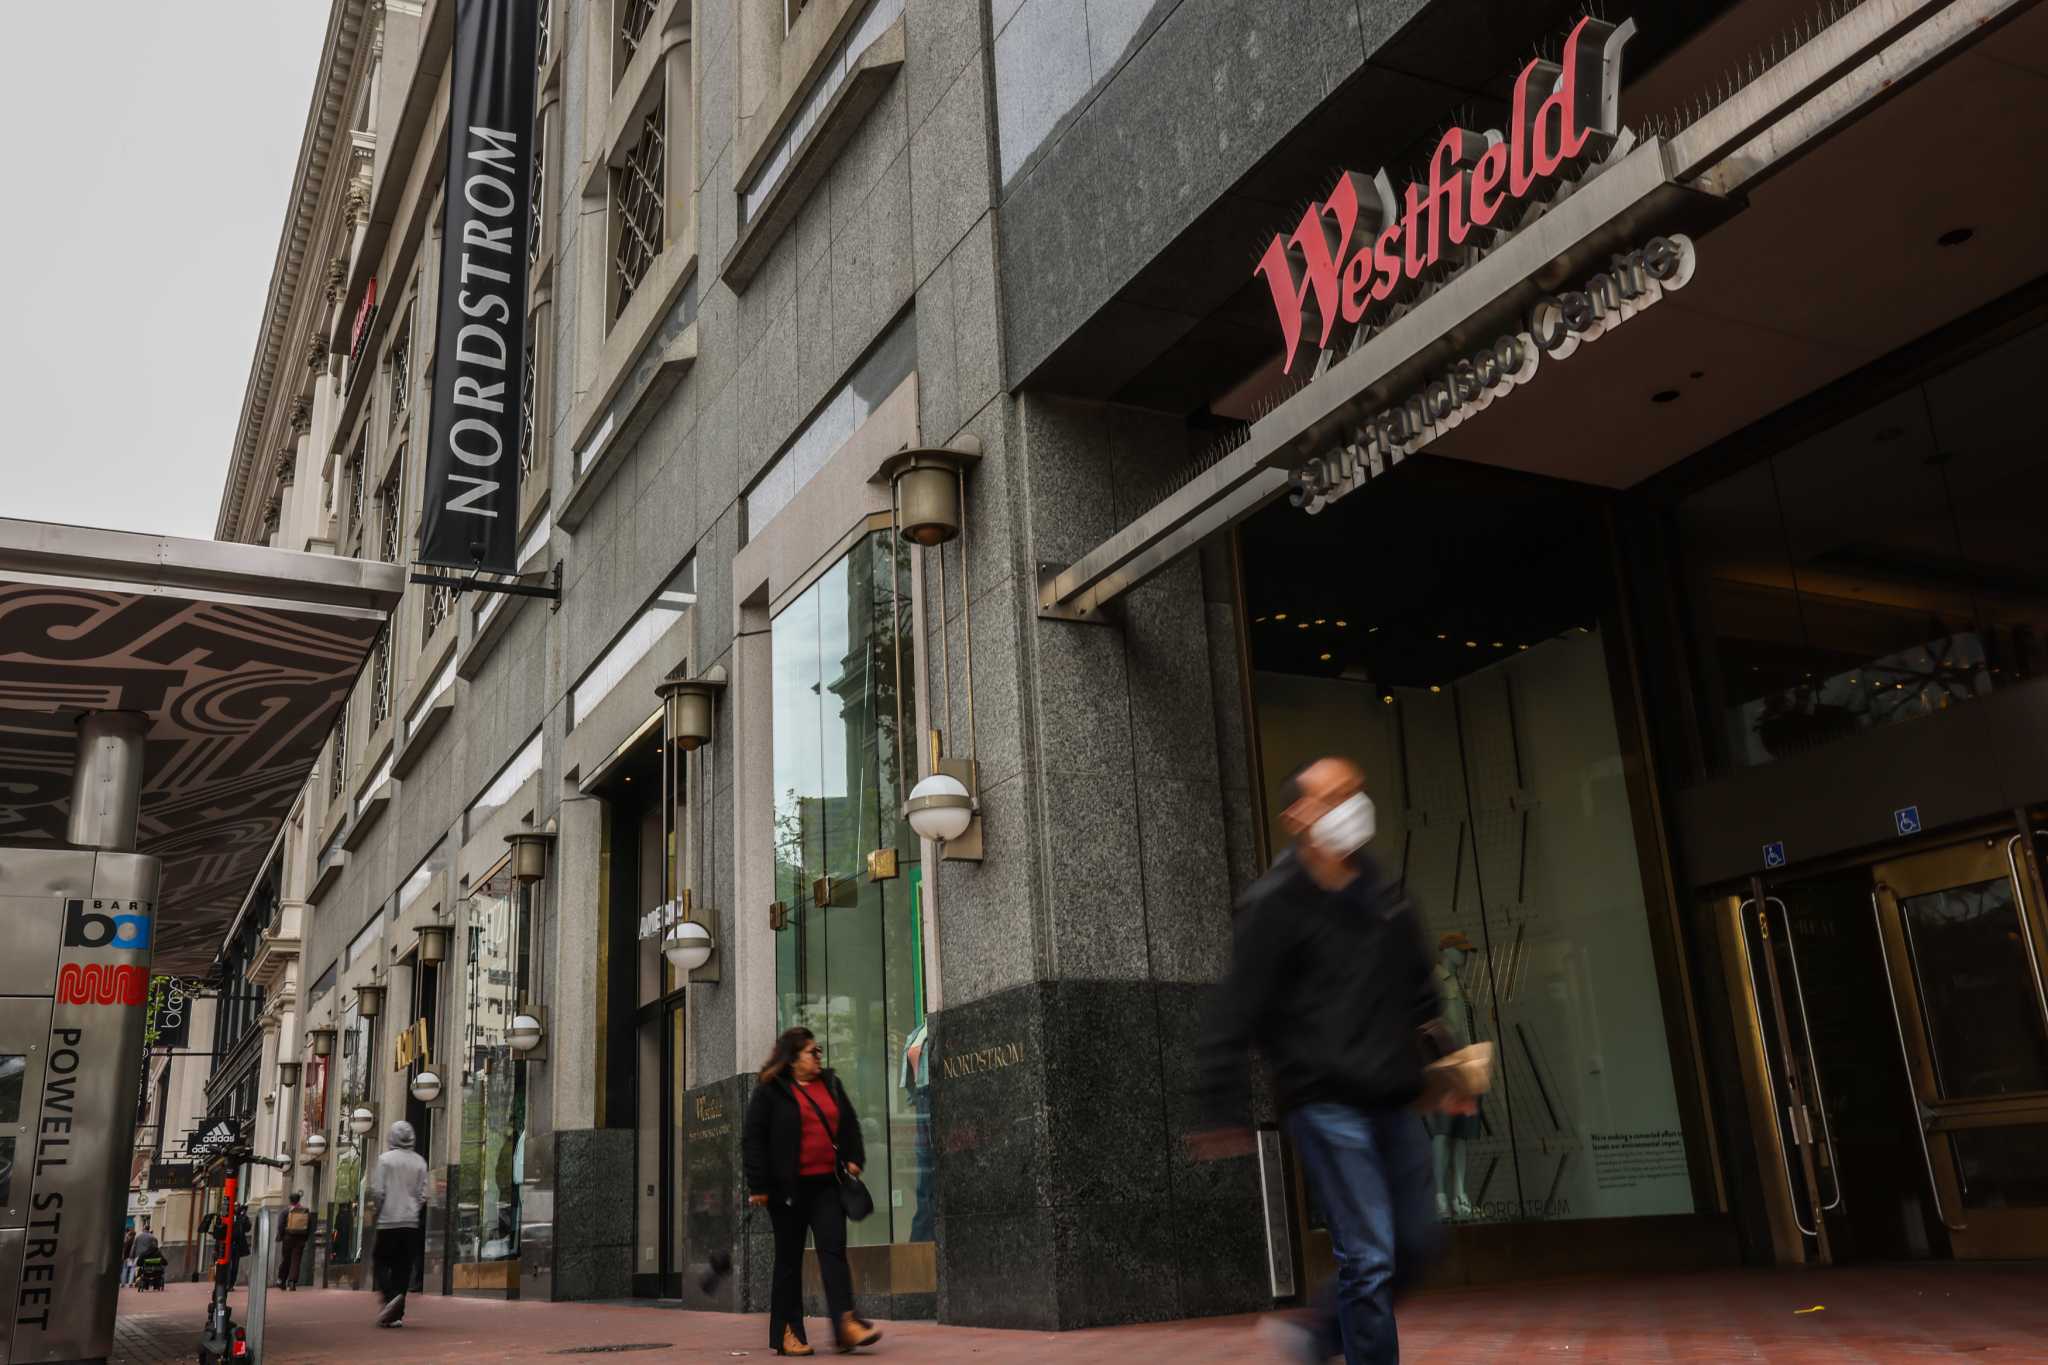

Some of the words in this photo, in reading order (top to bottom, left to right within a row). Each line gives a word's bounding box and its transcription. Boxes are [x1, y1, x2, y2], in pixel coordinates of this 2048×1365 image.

[1252, 15, 1598, 376] Westfield
[445, 126, 517, 518] NORDSTROM
[93, 900, 154, 912] BART
[36, 1028, 82, 1176] POWELL
[202, 1134, 235, 1143] adidas
[17, 1192, 64, 1331] STREET
